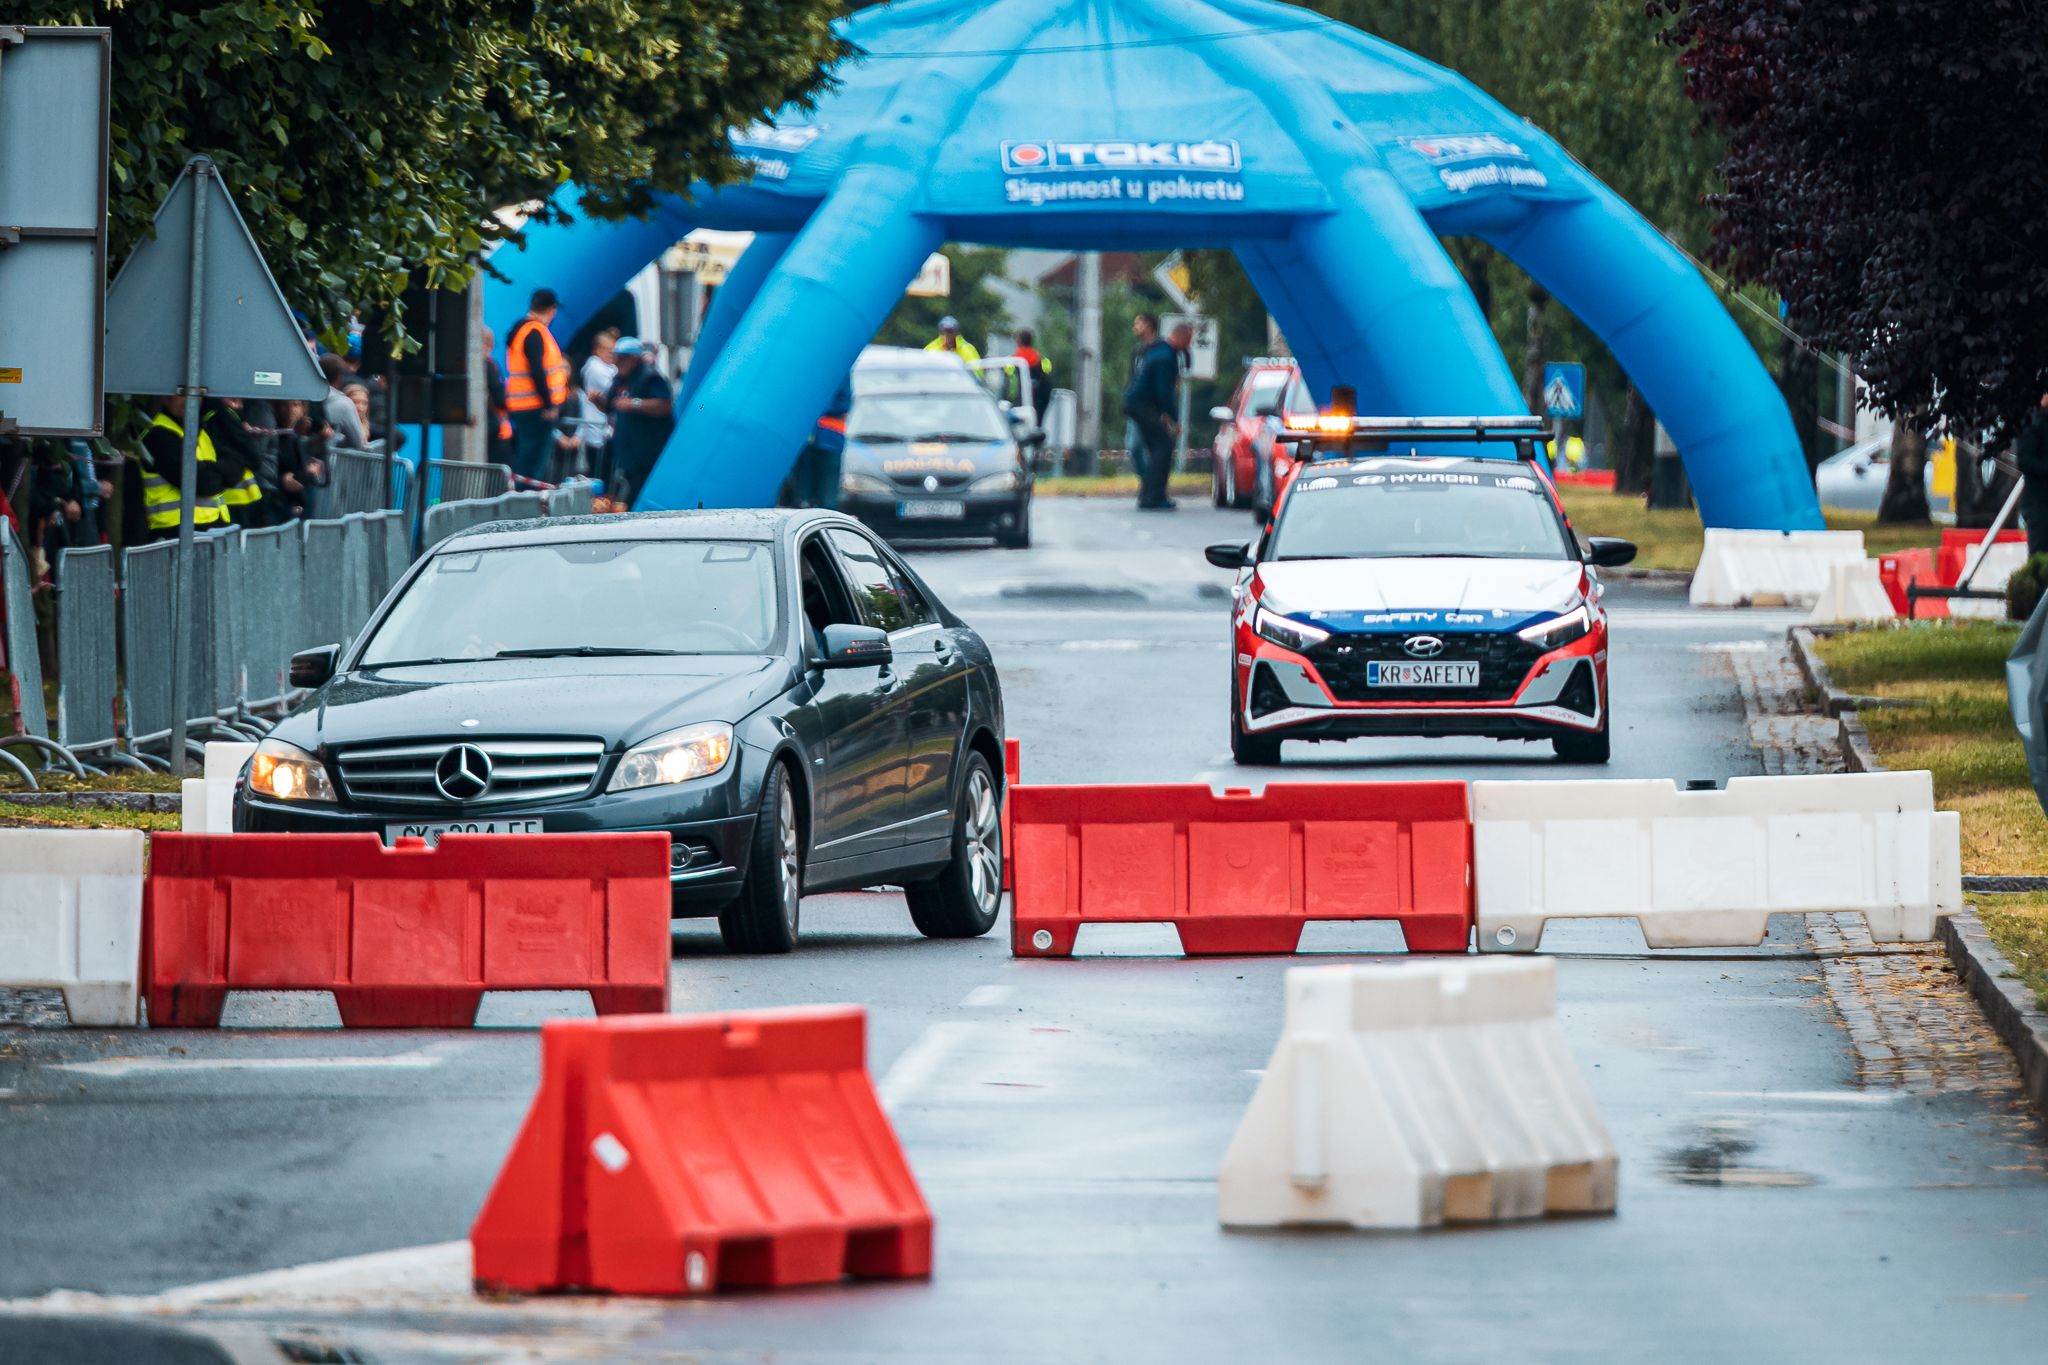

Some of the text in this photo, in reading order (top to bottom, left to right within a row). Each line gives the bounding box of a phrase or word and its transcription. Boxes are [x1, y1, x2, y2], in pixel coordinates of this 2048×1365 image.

[1056, 138, 1234, 167] TOKIĆ
[1004, 174, 1245, 206] Sigurnost u pokretu
[1390, 474, 1479, 485] HYUNDAI
[1363, 612, 1438, 624] SAFETY
[1444, 612, 1484, 624] CAR
[1380, 665, 1476, 684] KR SAFETY
